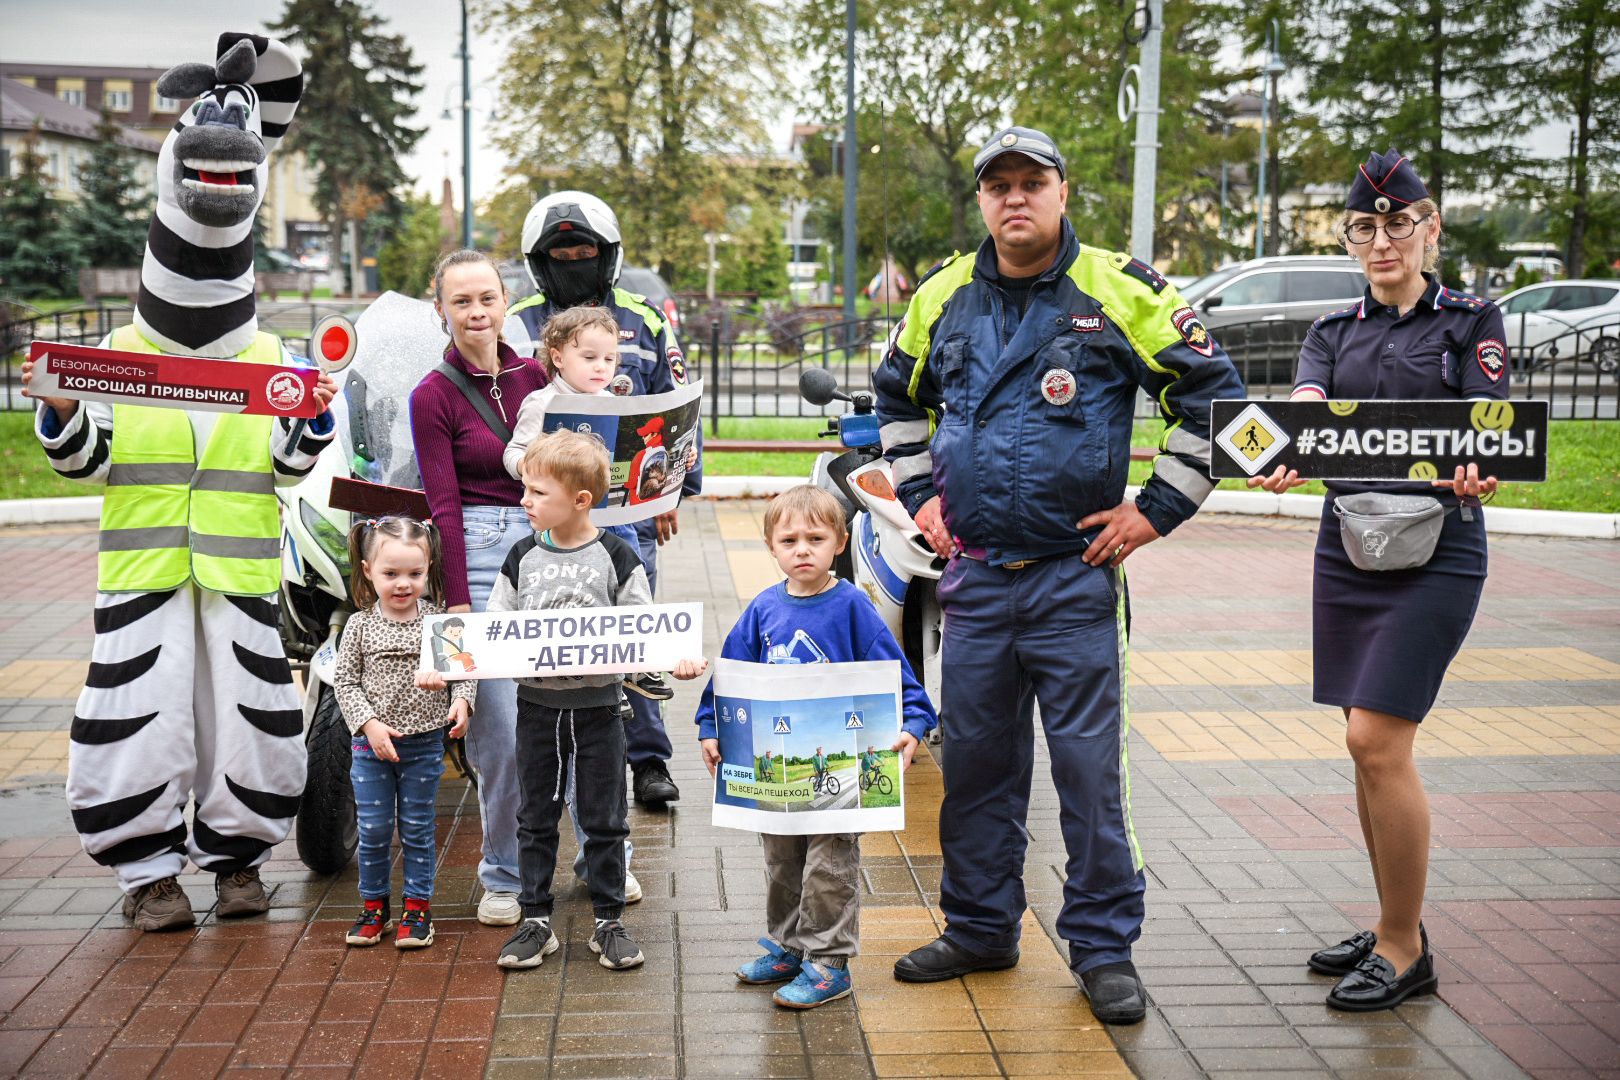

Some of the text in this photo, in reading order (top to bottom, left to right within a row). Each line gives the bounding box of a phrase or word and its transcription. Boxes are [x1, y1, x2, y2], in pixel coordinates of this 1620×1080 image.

[1071, 317, 1100, 329] ГИБДД
[52, 359, 146, 377] БЕЗОПАСНОСТЬ
[64, 376, 245, 403] ХОРОШАЯ ПРИВЫЧКА!
[1296, 428, 1536, 457] #ЗАСВЕТИСЬ!
[527, 562, 601, 588] DON'T
[485, 611, 693, 642] #АВТОКРЕСЛО
[527, 642, 646, 672] -ДЕТЯМ!
[723, 769, 753, 780] НА ЗЕБРЕ
[729, 783, 810, 797] ТЫ ВСЕГДА ПЕШЕХОД
